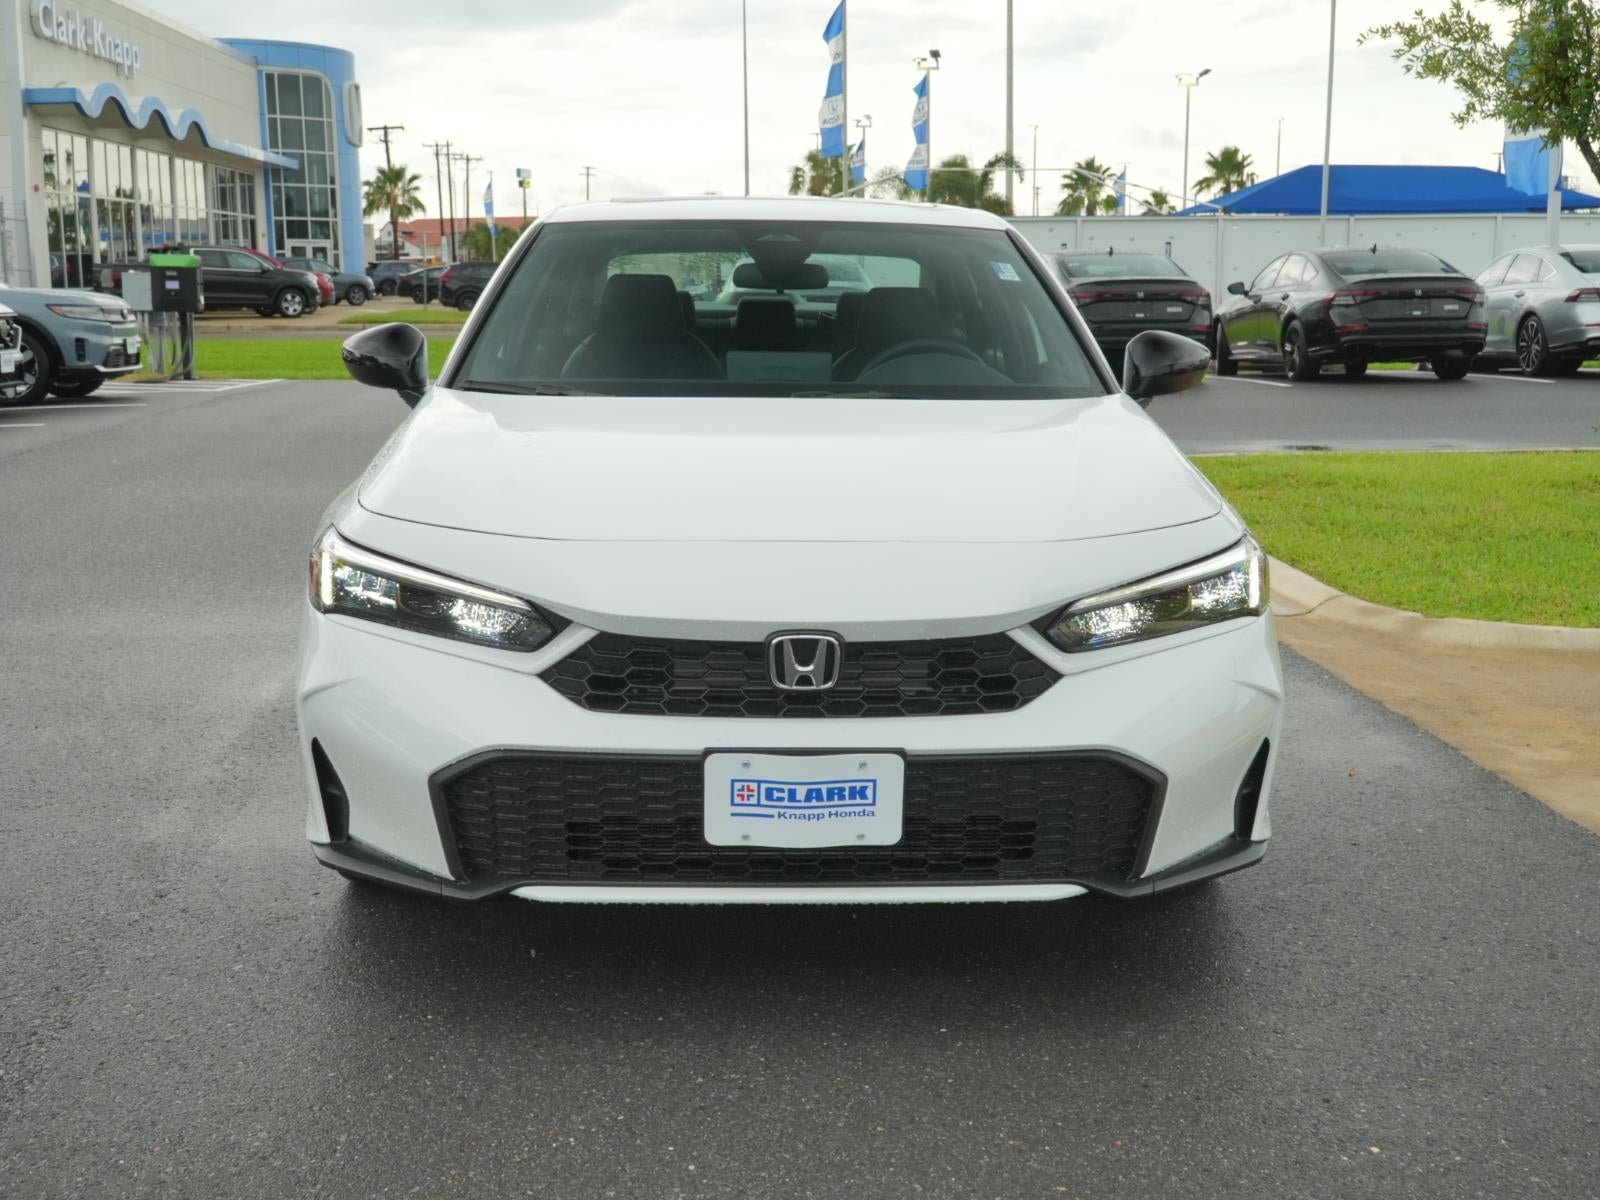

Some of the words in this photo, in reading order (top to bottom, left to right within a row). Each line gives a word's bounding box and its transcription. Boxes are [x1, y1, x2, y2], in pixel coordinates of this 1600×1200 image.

[36, 0, 141, 78] Clark-Knapp
[764, 786, 869, 803] CLARK
[777, 811, 825, 821] Knapp
[828, 809, 876, 819] Honda
